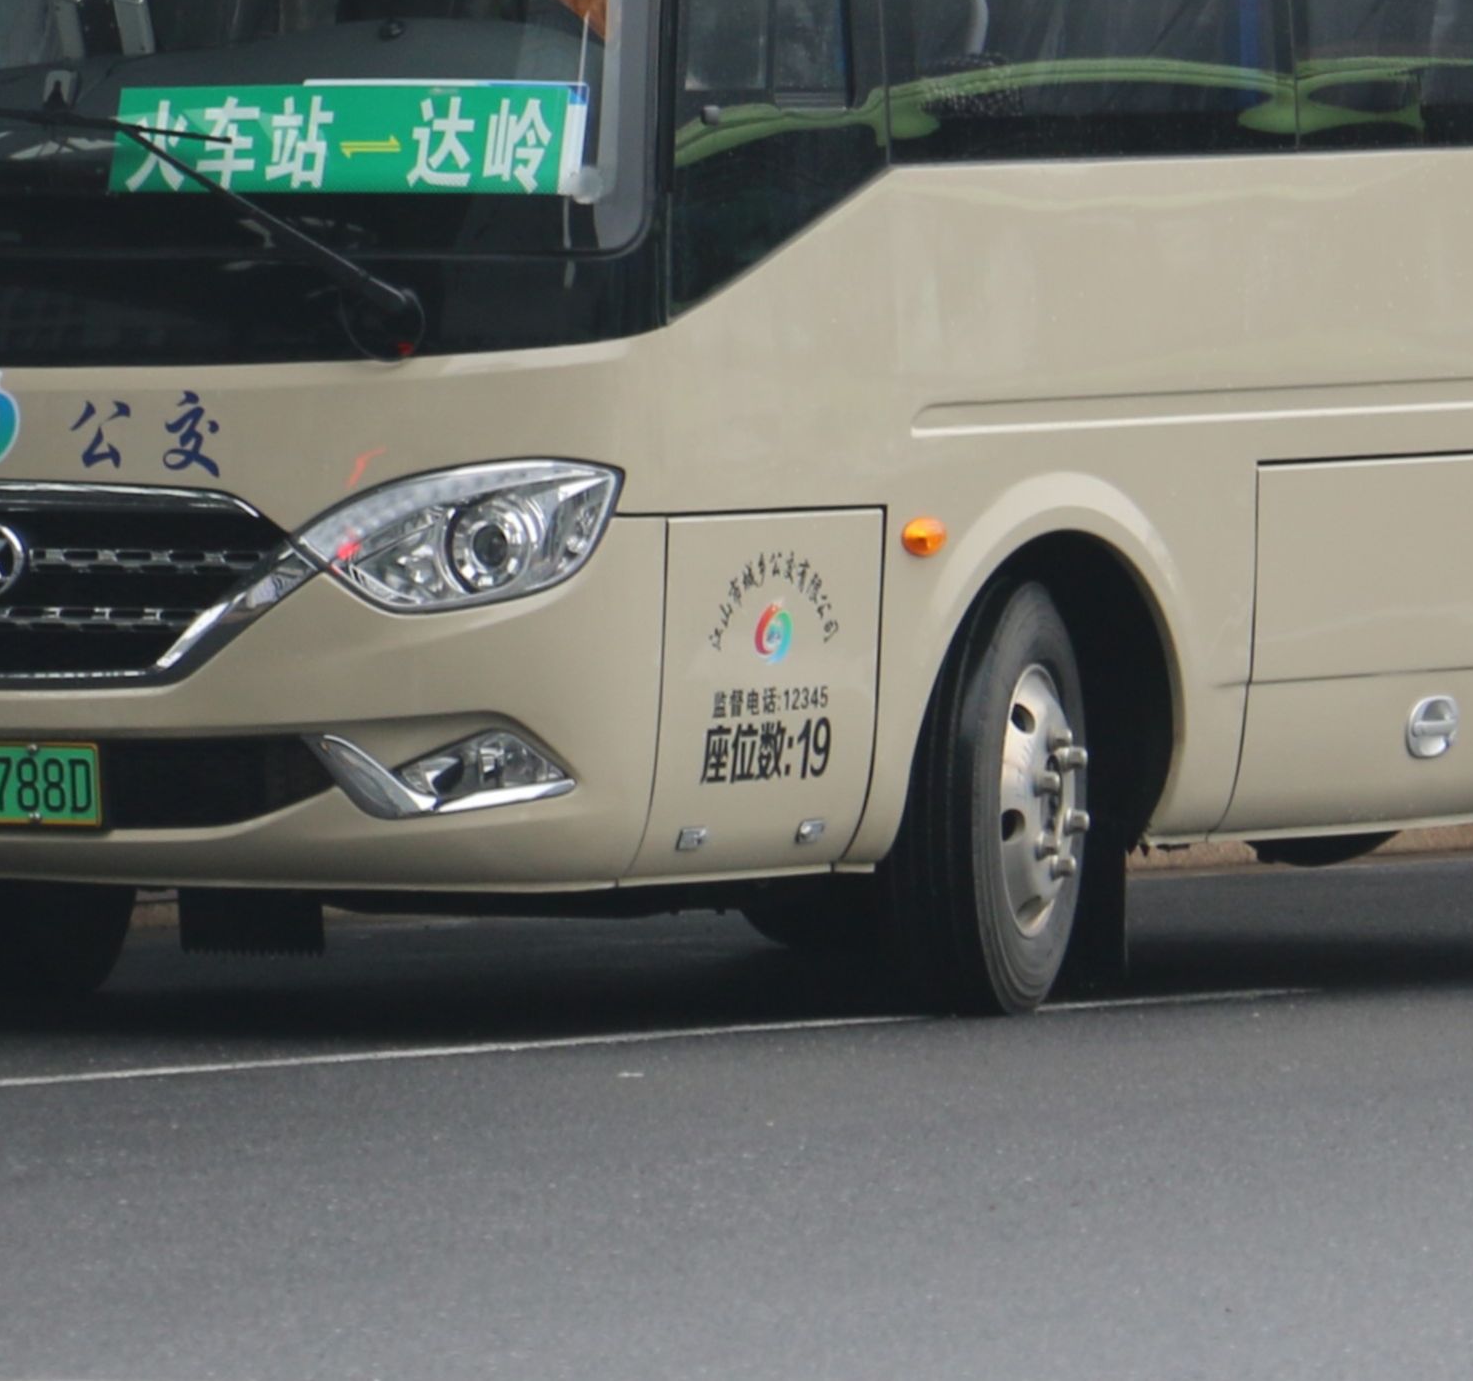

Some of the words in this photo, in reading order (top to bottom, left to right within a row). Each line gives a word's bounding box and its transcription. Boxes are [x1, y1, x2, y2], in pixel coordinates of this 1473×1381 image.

[126, 95, 335, 192] 火车站
[405, 97, 553, 194] 达岭
[70, 390, 222, 479] 公交
[708, 549, 840, 652] 江山市城乡公交有限公司
